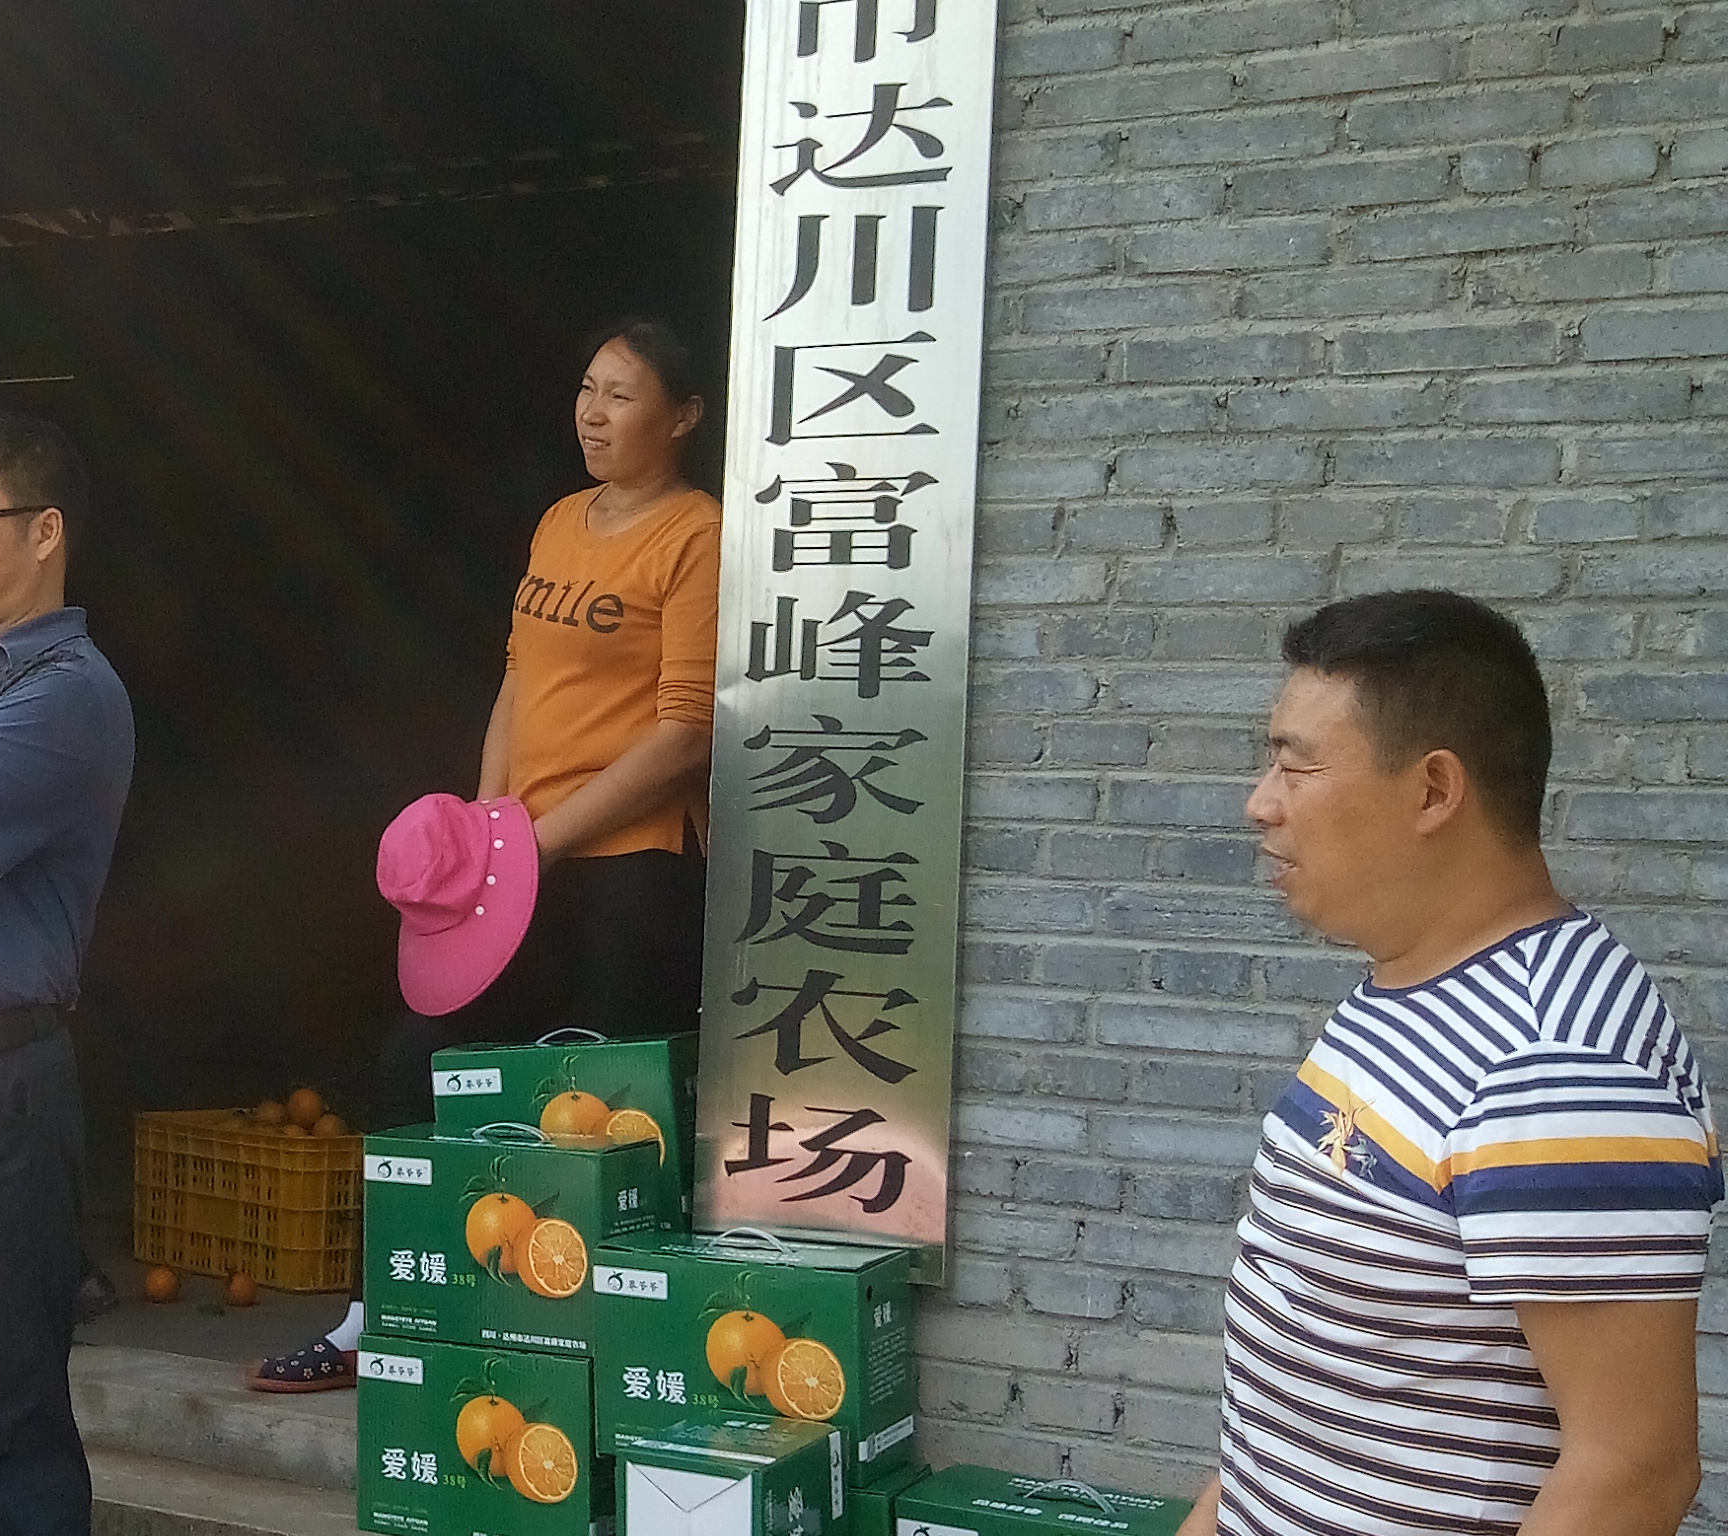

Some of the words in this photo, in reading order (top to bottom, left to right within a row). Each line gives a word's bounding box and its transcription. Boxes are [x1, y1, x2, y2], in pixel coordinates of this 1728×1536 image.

[388, 1249, 448, 1285] 爱媛
[451, 1273, 477, 1288] 38号
[622, 1366, 687, 1405] 爱媛
[381, 1447, 438, 1486] 爱媛
[443, 1474, 467, 1489] 38号
